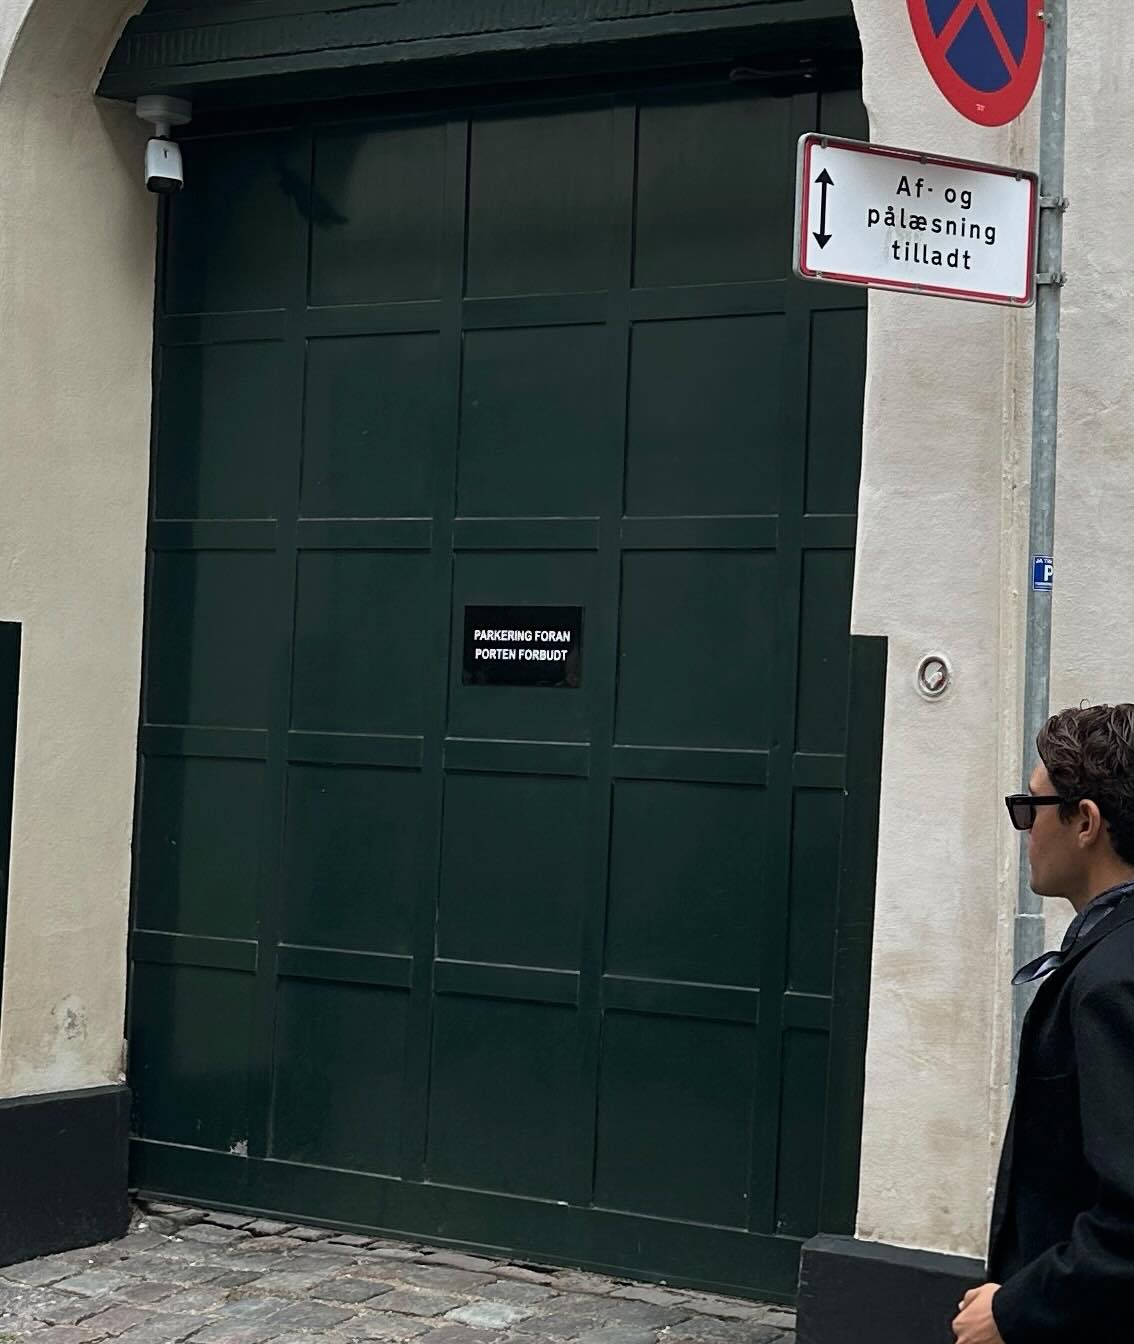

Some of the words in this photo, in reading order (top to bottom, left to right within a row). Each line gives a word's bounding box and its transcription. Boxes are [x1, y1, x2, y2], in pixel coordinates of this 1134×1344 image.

[896, 175, 933, 198] Af-
[944, 187, 972, 210] og
[867, 205, 996, 246] pålæsning
[891, 239, 971, 270] tilladt
[473, 629, 532, 642] PARKERING
[534, 630, 571, 643] FORAN
[475, 648, 516, 660] PORTEN
[518, 649, 568, 662] FORBUDT
